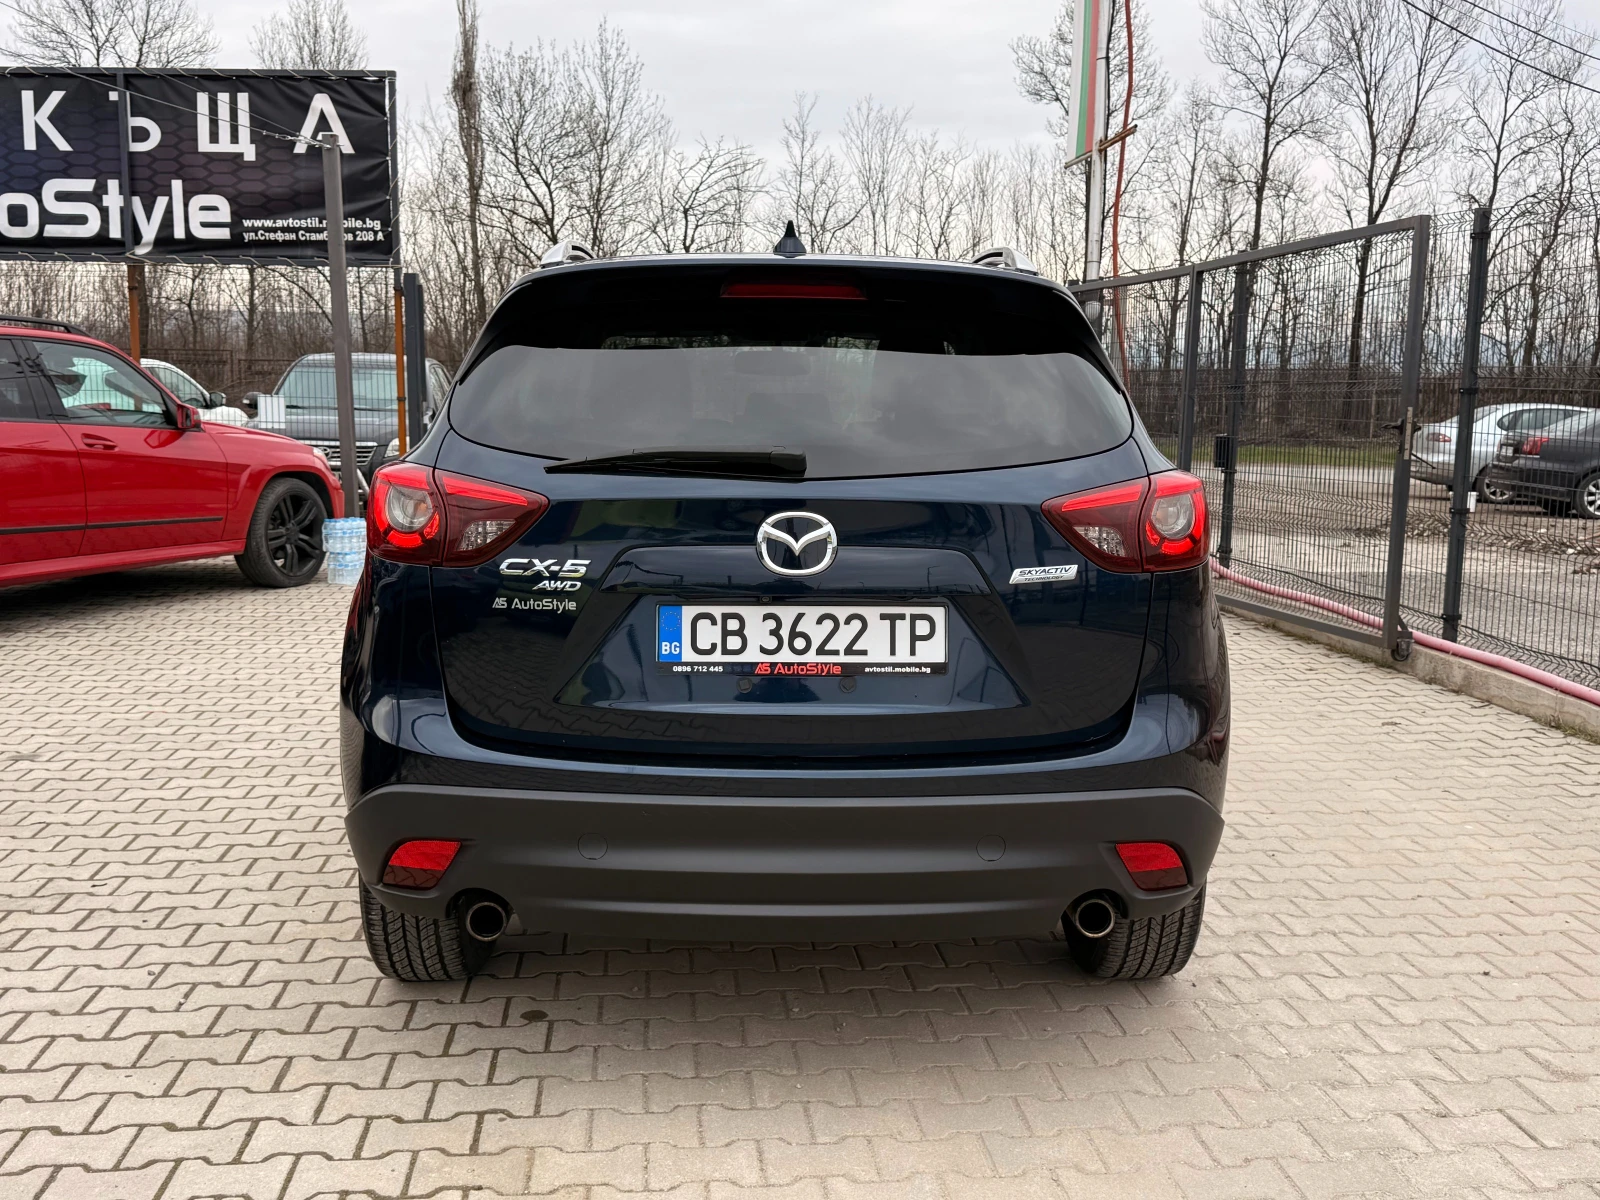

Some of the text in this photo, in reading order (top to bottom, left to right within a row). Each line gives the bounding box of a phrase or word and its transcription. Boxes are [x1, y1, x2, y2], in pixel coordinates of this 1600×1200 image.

[242, 216, 381, 231] www.avtostil.bile.bg
[298, 230, 354, 242] Стамбов
[355, 230, 375, 242] 208
[499, 558, 592, 578] CX-5
[1019, 566, 1072, 576] SKYACTIV
[532, 580, 582, 592] AWD
[511, 598, 577, 614] AutoStyle
[690, 612, 937, 657] CB 3622 TP
[661, 641, 680, 655] BG
[774, 663, 842, 676] AutoStyle
[864, 666, 931, 674] avtostil.mobile.bg
